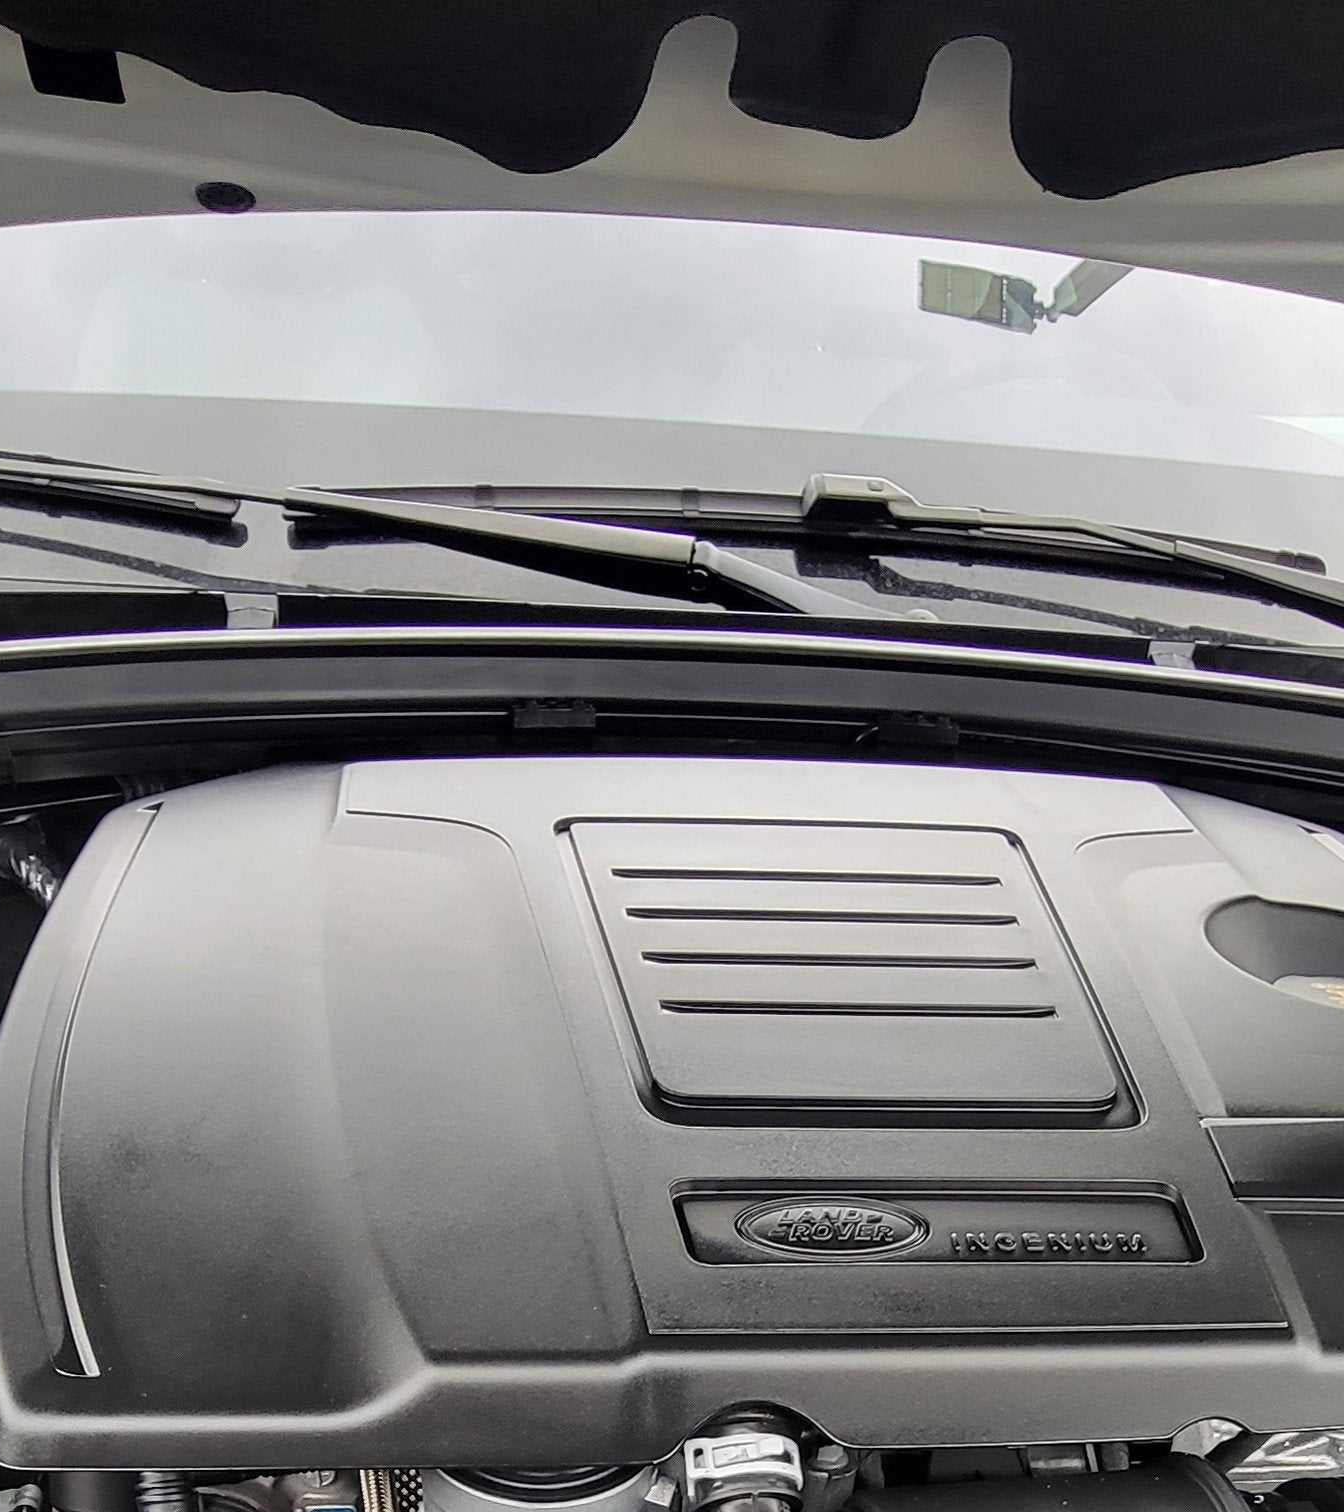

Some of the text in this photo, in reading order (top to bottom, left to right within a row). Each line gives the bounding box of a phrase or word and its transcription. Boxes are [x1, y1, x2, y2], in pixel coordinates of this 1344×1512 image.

[777, 1208, 863, 1224] LAND
[788, 1222, 895, 1243] ROVER
[950, 1230, 1148, 1254] INGENIUM
